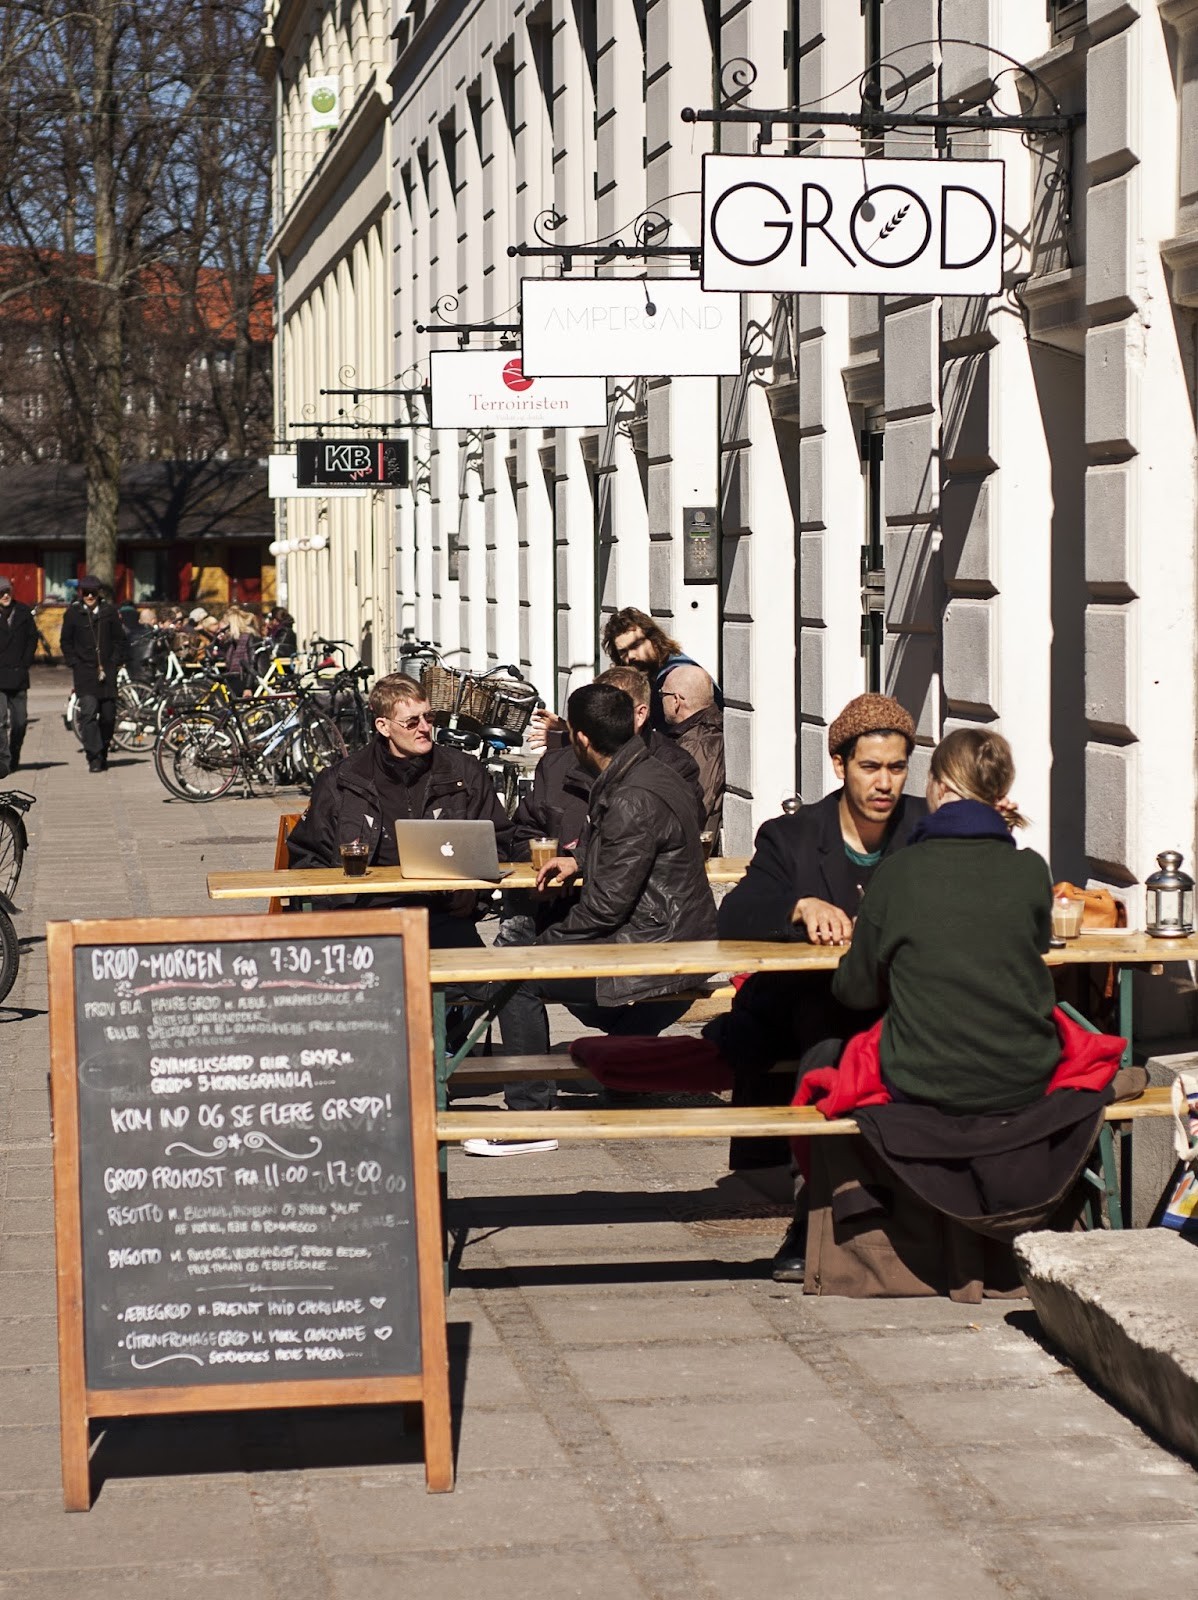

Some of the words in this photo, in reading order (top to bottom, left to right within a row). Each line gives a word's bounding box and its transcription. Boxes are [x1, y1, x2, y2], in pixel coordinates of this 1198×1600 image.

[469, 394, 569, 411] Terroiristen
[325, 445, 371, 472] KB
[110, 1106, 153, 1134] KOM
[160, 1105, 191, 1128] IND
[198, 1103, 226, 1129] OG
[230, 1104, 256, 1128] SE
[260, 1100, 315, 1126] FLERE
[151, 1165, 228, 1190] FROKOST
